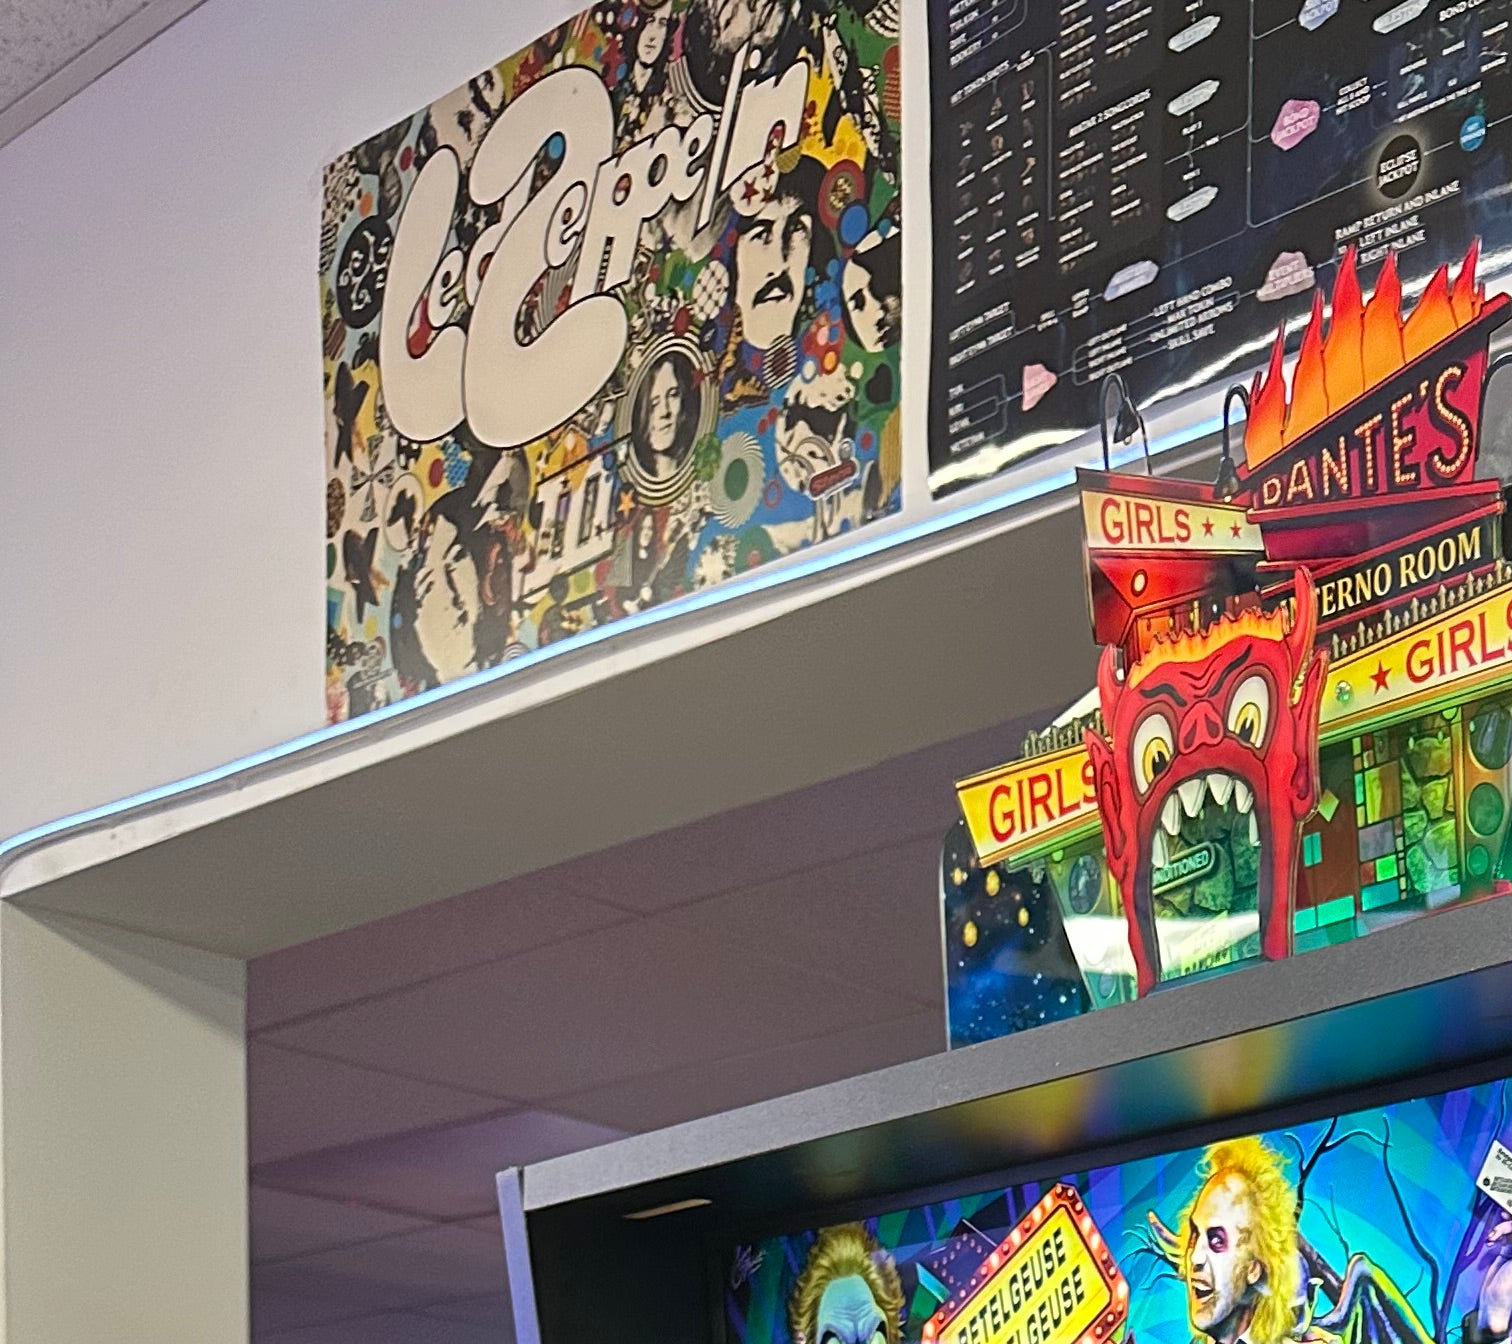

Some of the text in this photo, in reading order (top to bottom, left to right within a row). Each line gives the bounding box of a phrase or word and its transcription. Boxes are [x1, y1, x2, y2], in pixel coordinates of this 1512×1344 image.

[1378, 161, 1418, 189] JACKPOT
[1380, 150, 1417, 173] ECLIPSE
[1262, 364, 1470, 506] DANTE'S
[1101, 498, 1192, 544] GIRLS
[1400, 527, 1480, 588] ROOM
[989, 761, 1099, 844] GIRLS
